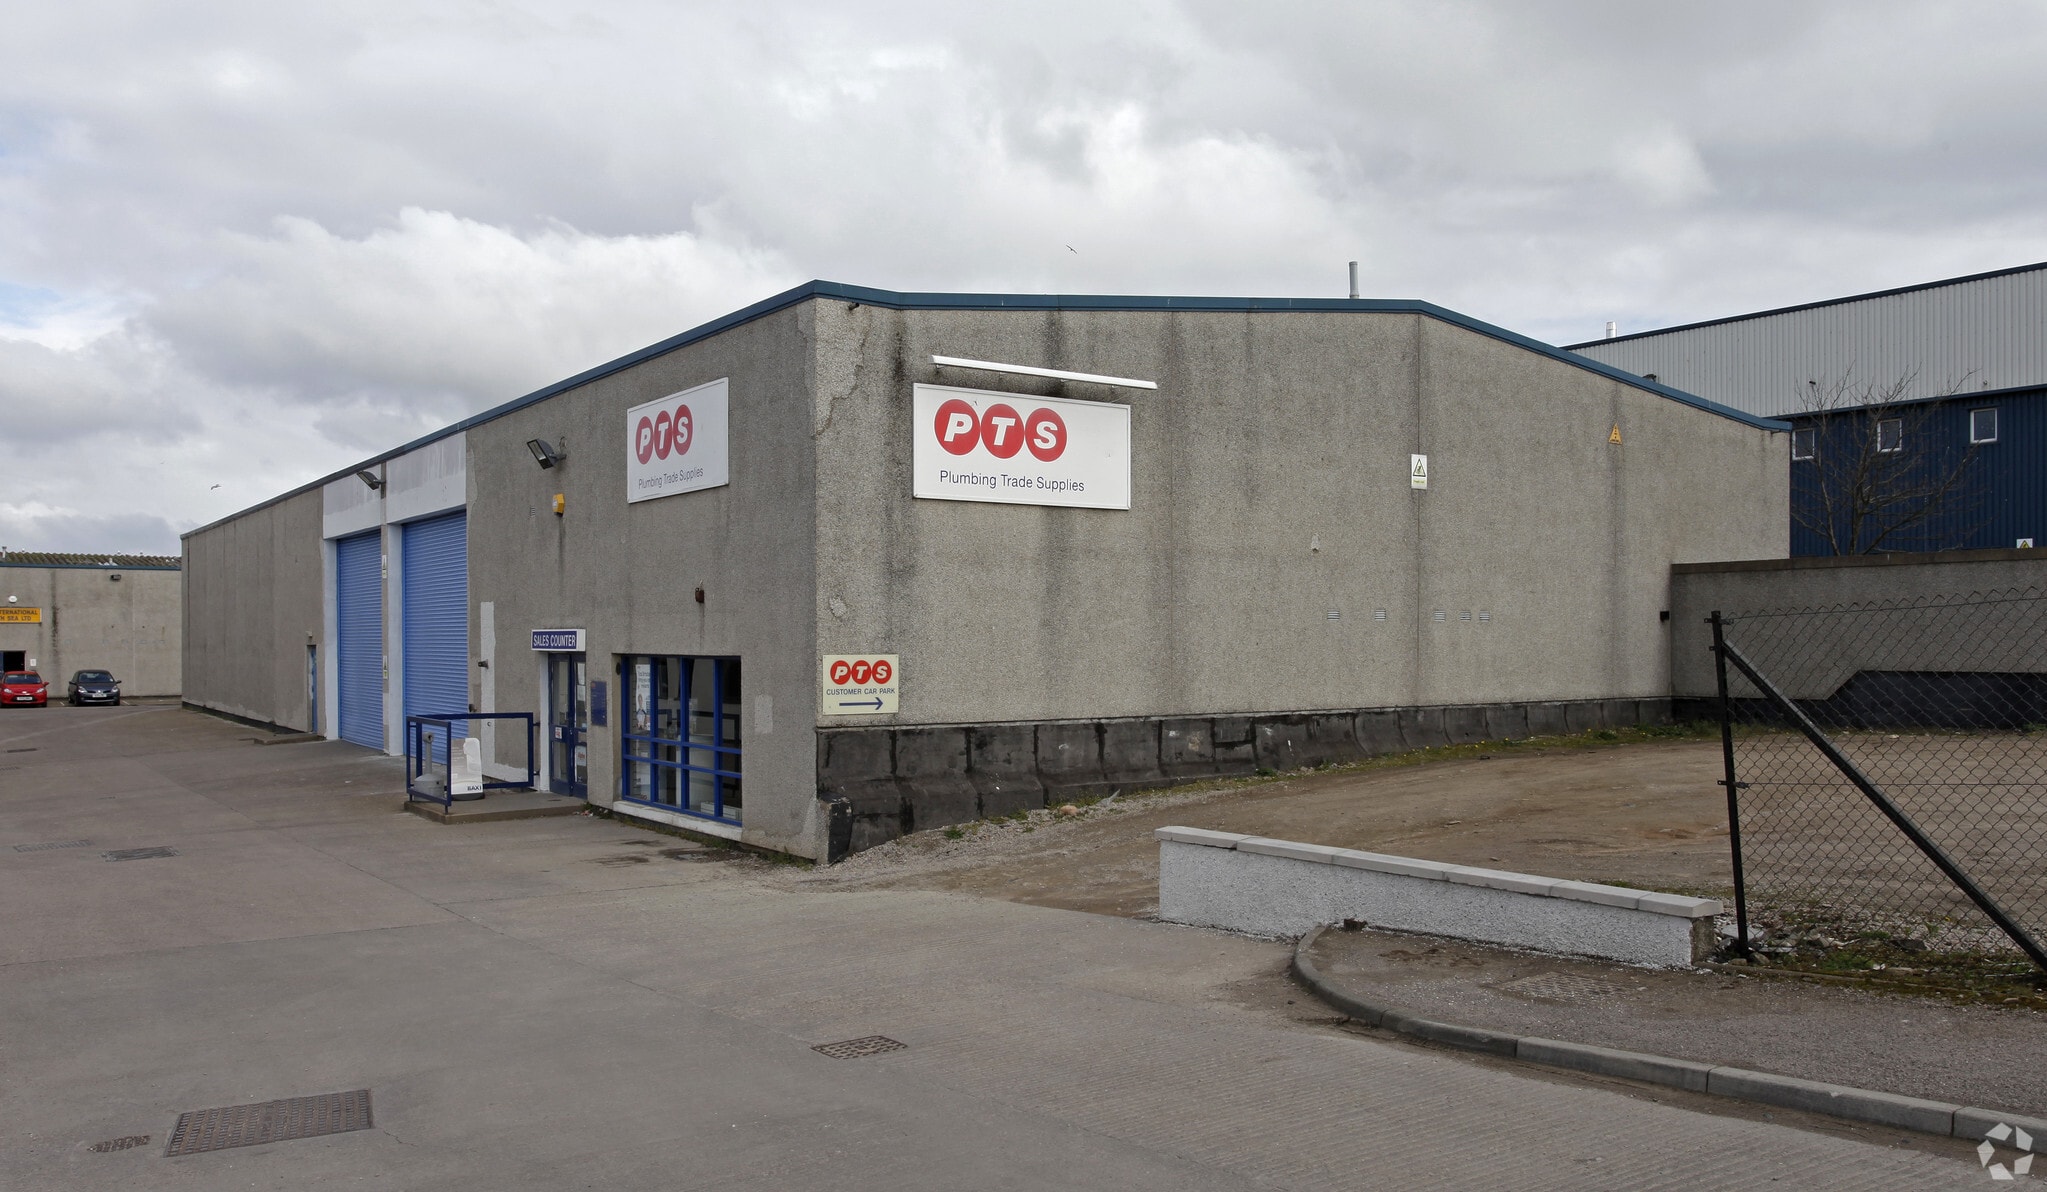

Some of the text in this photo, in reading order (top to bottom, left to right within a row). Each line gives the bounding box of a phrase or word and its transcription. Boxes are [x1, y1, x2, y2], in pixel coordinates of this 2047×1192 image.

[638, 414, 689, 457] PTS
[941, 410, 1061, 453] PTS
[638, 467, 704, 490] Plumbing Trade Supplies
[940, 470, 1085, 492] Plumbing Trade Supplies
[533, 634, 576, 647] SALES COUNTER
[832, 664, 889, 681] PTS
[826, 688, 862, 696] CUSTOMER
